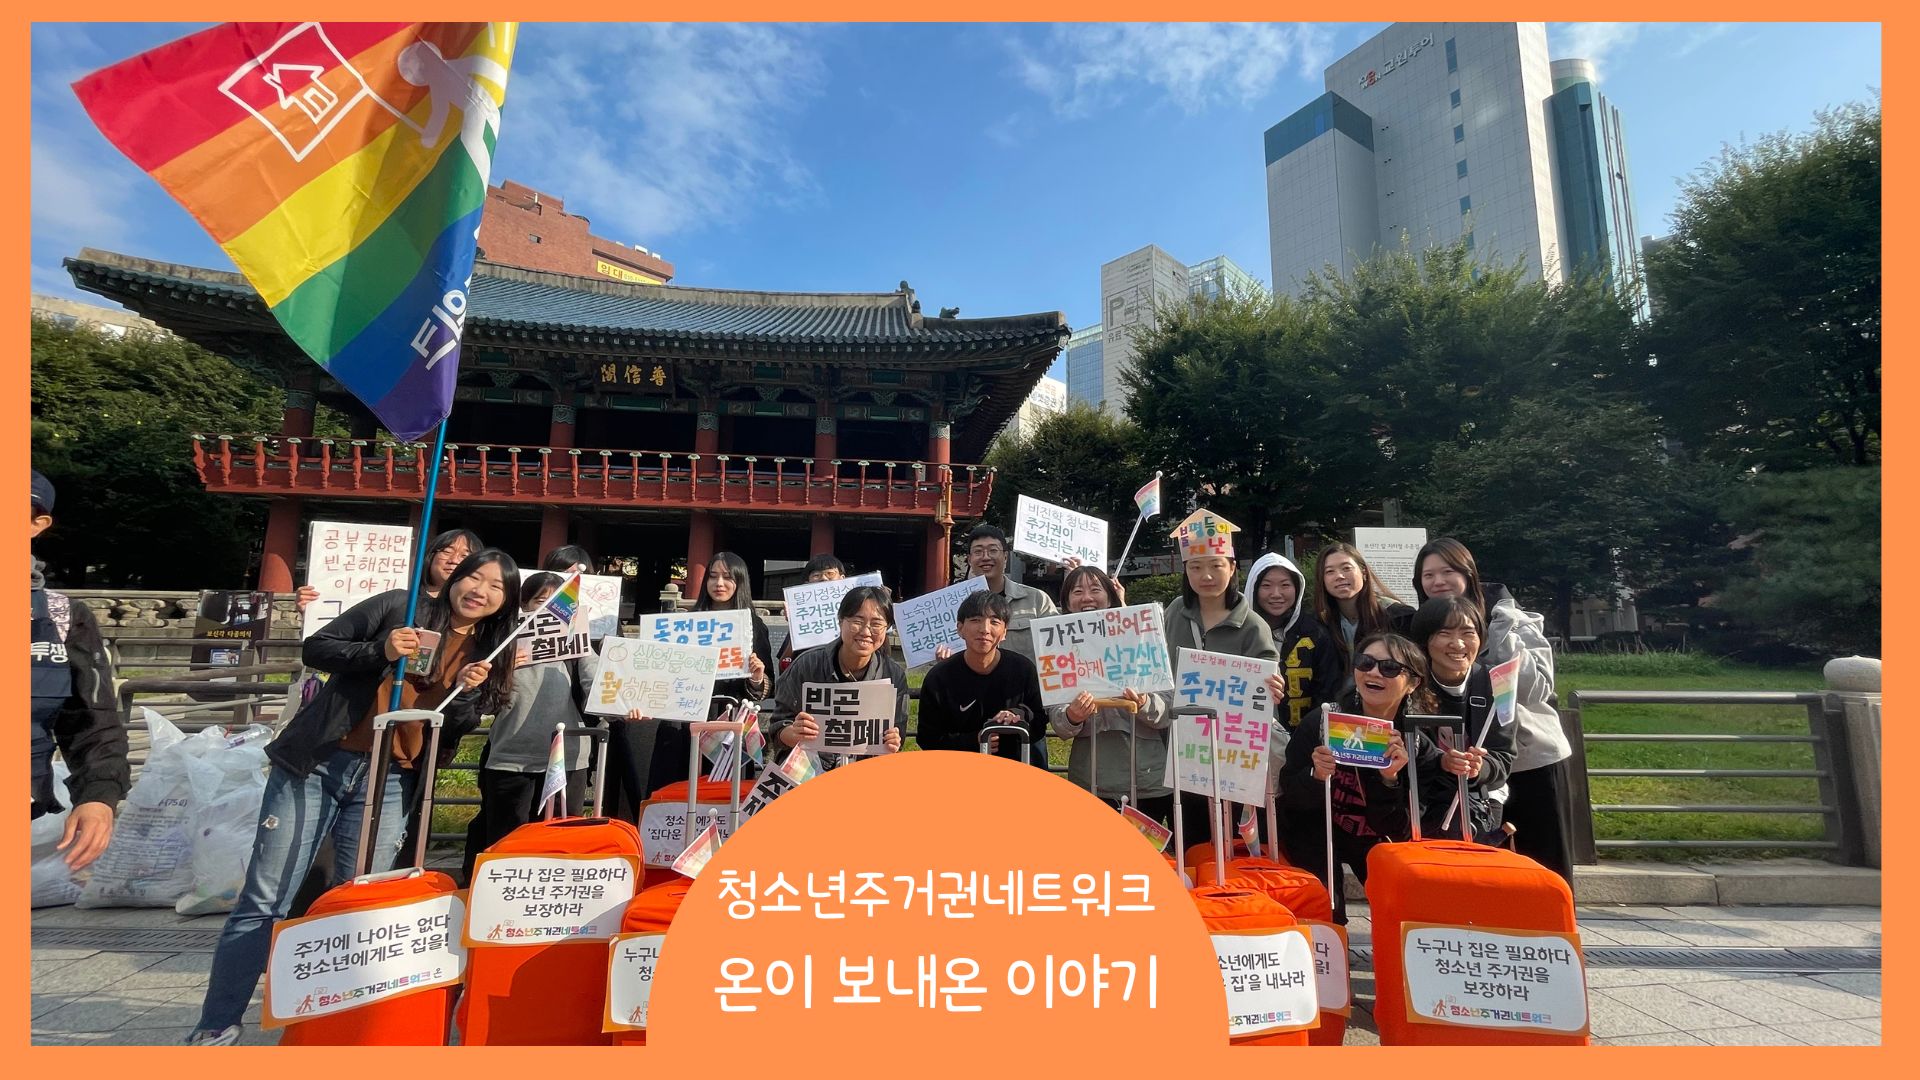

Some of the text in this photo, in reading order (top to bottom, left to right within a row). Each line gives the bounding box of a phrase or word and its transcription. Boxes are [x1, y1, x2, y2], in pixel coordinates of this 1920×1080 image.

[1383, 32, 1434, 76] 교원투어
[601, 264, 623, 279] 임대
[1026, 516, 1073, 541] 주거권이
[1028, 503, 1101, 534] 비진학 청년도
[324, 529, 407, 553] 공부 못하면
[1025, 531, 1100, 563] 보장되는 세상
[334, 577, 397, 593] 이야기
[906, 611, 957, 637] 주거권이
[1038, 651, 1105, 692] 존엄하게
[805, 687, 860, 716] 빈곤
[824, 718, 890, 747] 철폐!
[1195, 711, 1269, 751] 기본권
[487, 867, 628, 883] 누구나 집은 필요하다
[502, 884, 605, 901] 청소년 주거권을
[522, 902, 584, 918] 보장하라
[293, 914, 452, 959] 주거에 나이는 없다
[505, 925, 598, 938] 청소년주거권네트워크
[292, 932, 450, 981] 청소년에게도 집을!
[1416, 937, 1571, 965] 누구나 집은 필요하다
[1231, 970, 1306, 993] 집'을 내놔라
[1435, 957, 1550, 984] 청소년 주거권을
[318, 971, 431, 1007] 청소년주거권네트워크
[1464, 981, 1530, 1001] 보장하라
[1450, 1004, 1552, 1025] 청소년주거권네트워크
